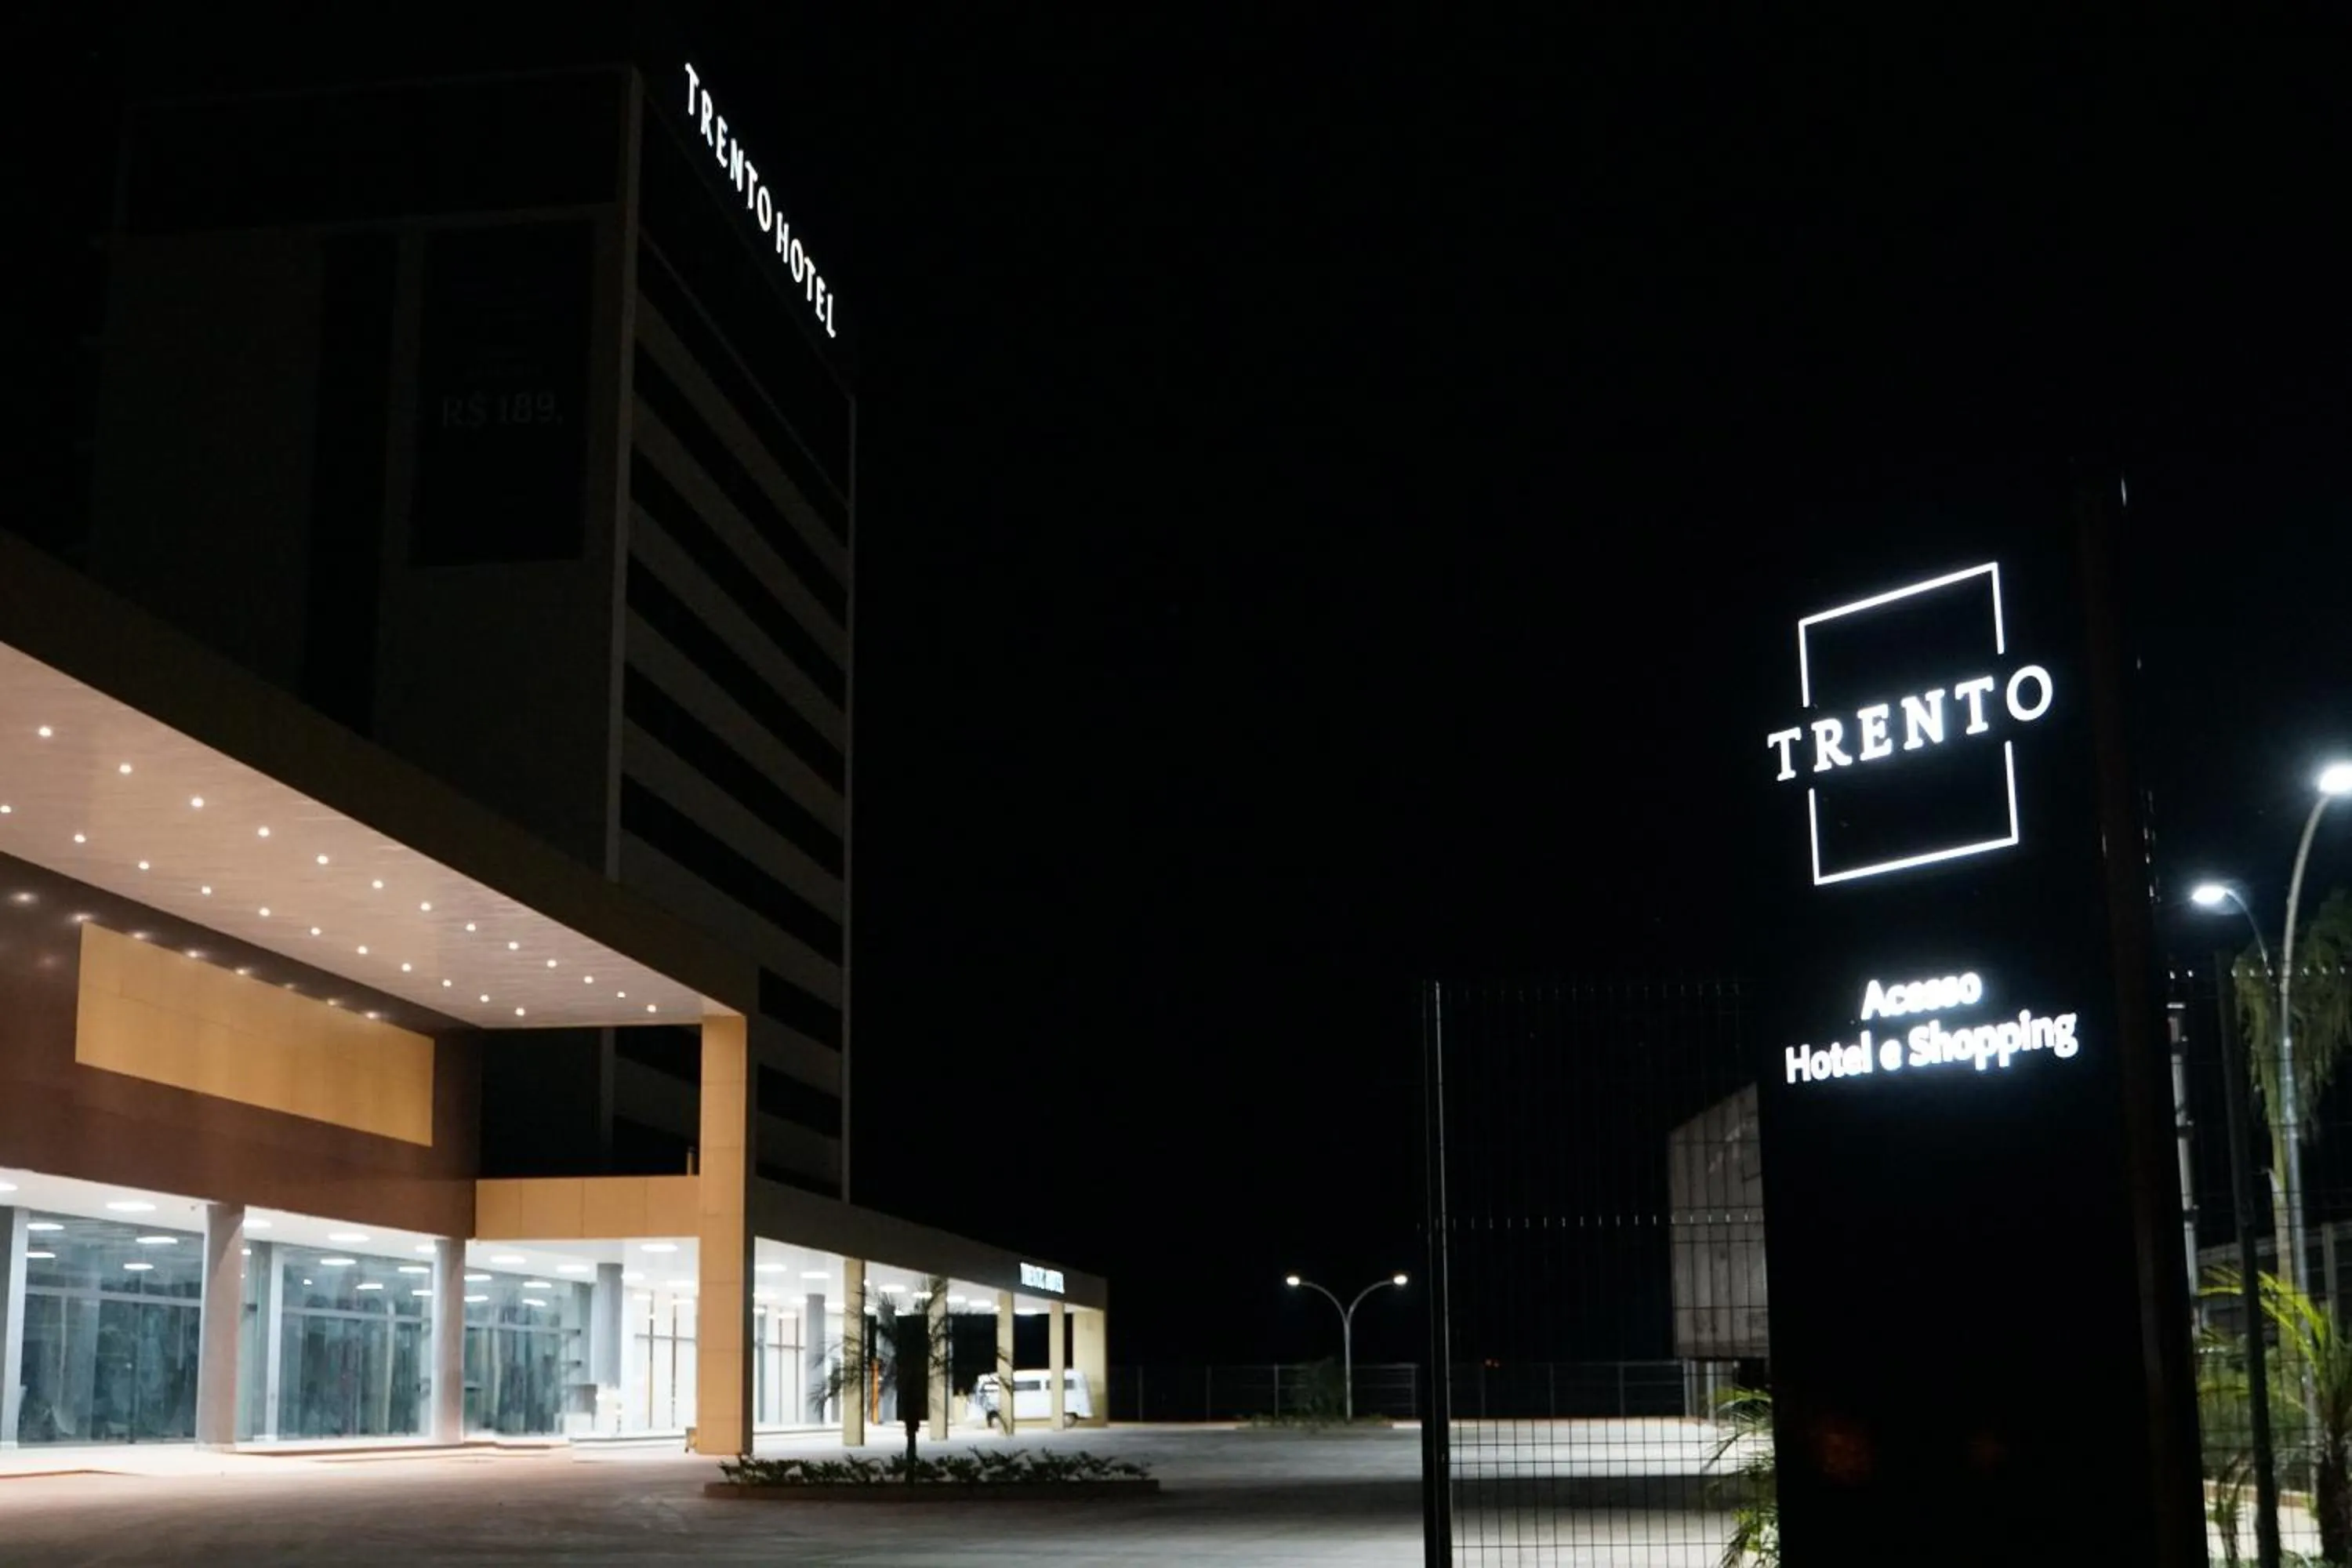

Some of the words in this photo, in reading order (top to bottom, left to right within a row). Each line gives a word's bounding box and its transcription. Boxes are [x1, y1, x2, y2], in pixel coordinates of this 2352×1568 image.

[684, 63, 772, 232] TRENTO
[775, 211, 837, 338] HOTEL
[442, 390, 488, 429] R$
[1767, 665, 2053, 782] TRENTO
[1785, 1029, 1872, 1083] Hotel
[1879, 1039, 1903, 1071] e
[1908, 1009, 2078, 1072] Shopping
